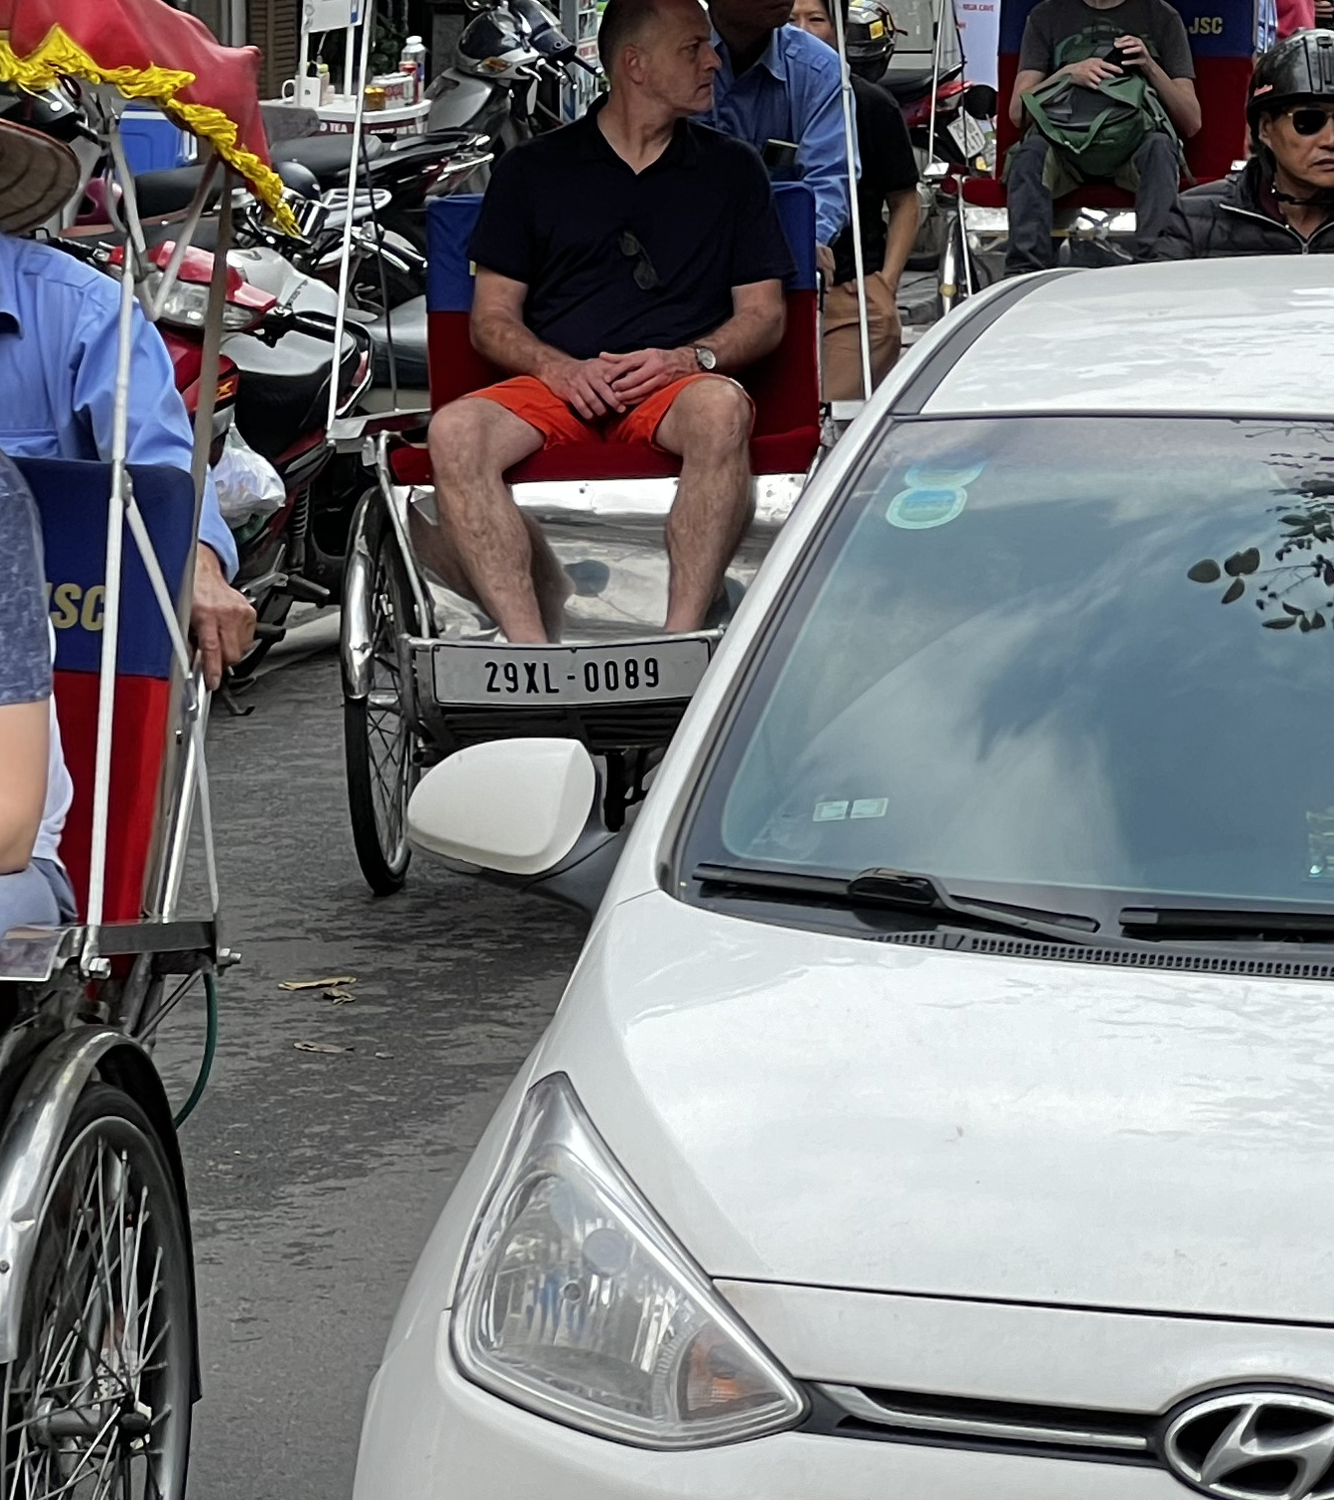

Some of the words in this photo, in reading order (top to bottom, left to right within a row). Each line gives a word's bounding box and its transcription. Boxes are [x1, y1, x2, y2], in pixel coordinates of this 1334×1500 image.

[1188, 16, 1224, 35] JSC
[329, 122, 349, 134] TEA
[45, 581, 106, 631] SC
